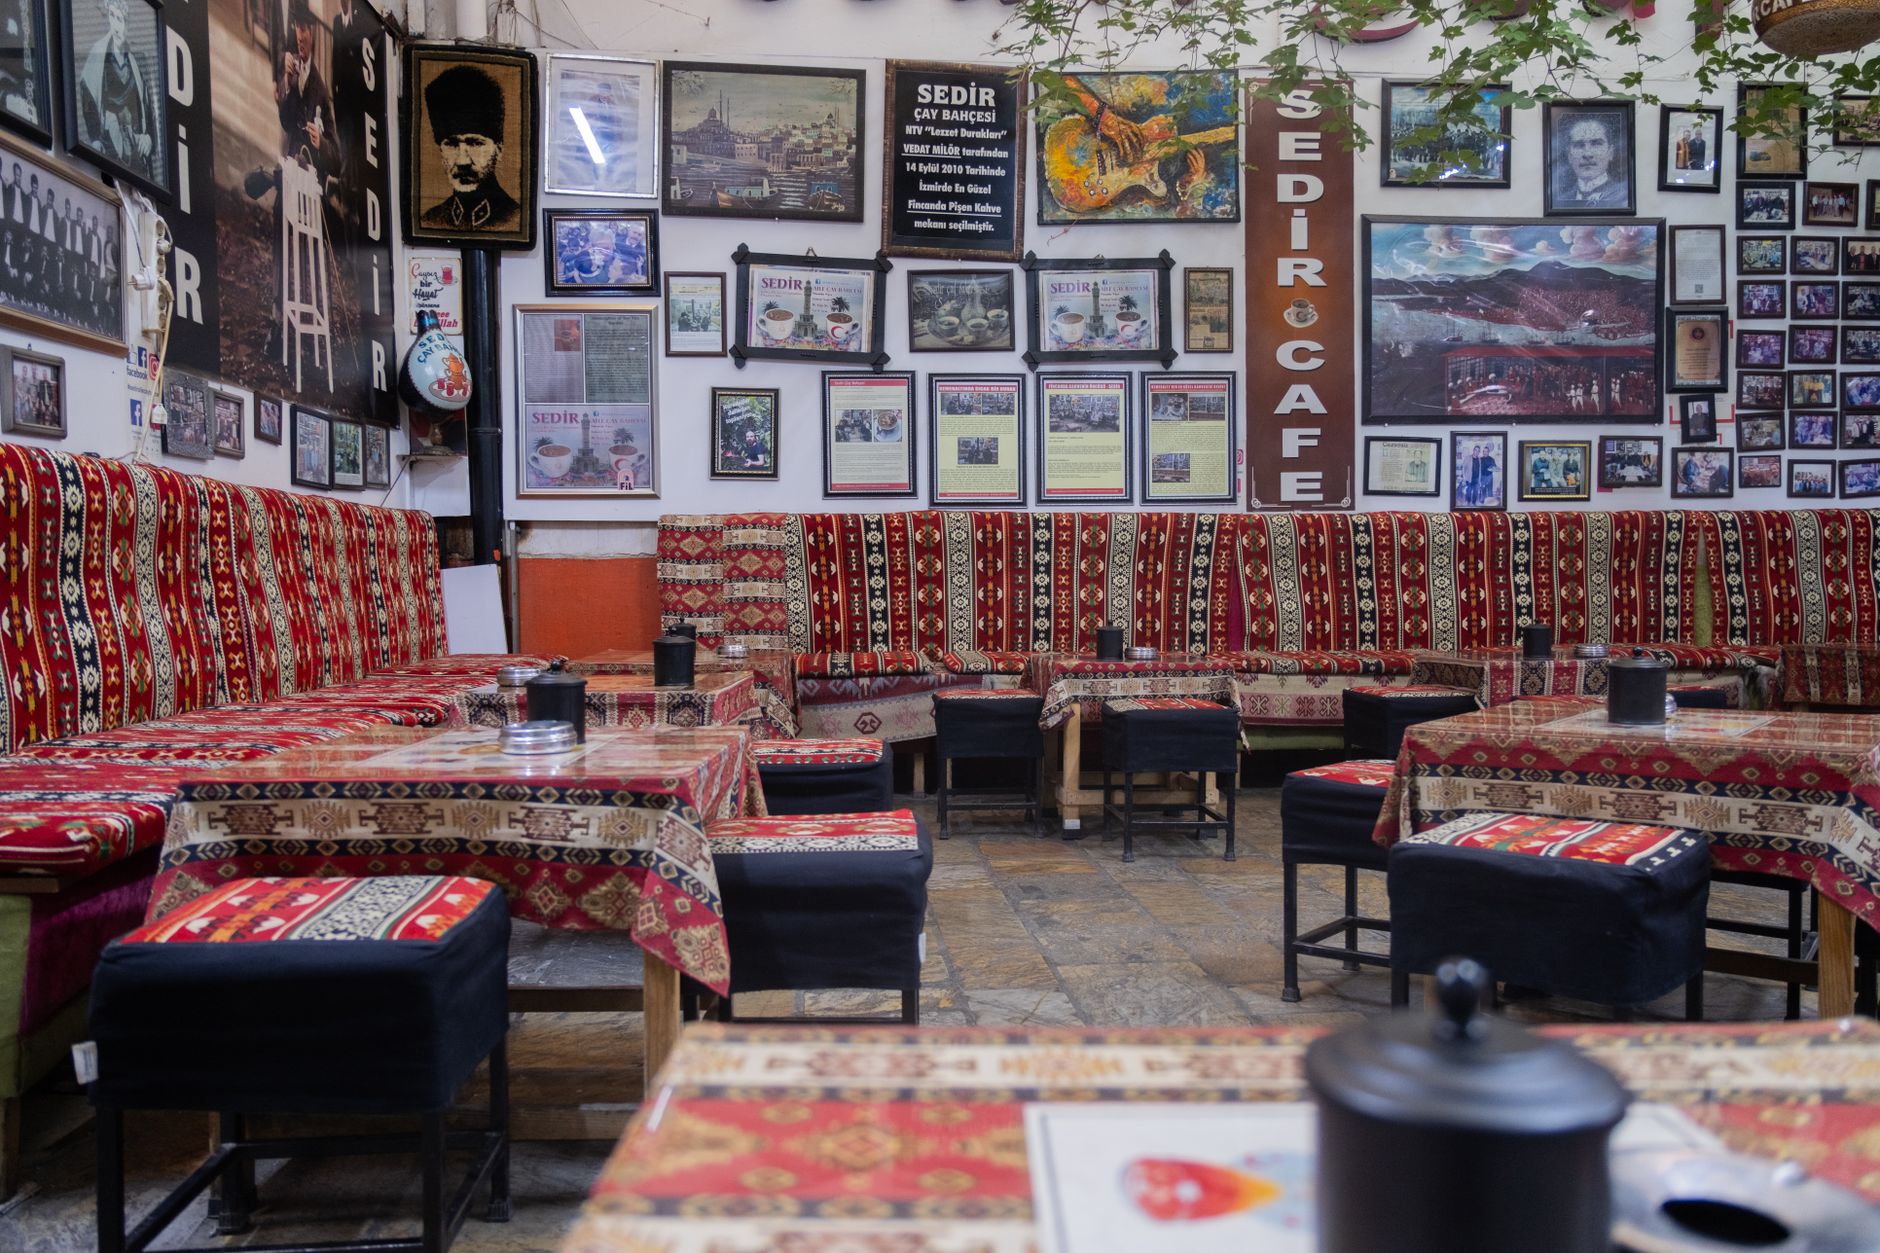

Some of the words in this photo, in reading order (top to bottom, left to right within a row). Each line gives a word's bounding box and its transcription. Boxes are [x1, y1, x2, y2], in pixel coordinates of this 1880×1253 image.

[917, 81, 996, 107] SEDİR
[914, 108, 938, 122] ÇAY
[942, 109, 996, 125] BAHÇESİ
[905, 125, 923, 135] NTV
[903, 143, 930, 154] VEDAT
[932, 143, 960, 155] MİLÖR
[962, 146, 1009, 158] tarafından
[165, 0, 203, 325] DİR
[905, 162, 916, 172] 14
[918, 162, 939, 174] Eylül
[941, 164, 963, 174] 2010
[965, 165, 1006, 176] Tarihinde
[919, 178, 952, 192] İzmirde
[954, 183, 965, 193] En
[967, 184, 991, 194] Güzel
[1276, 89, 1328, 287] SEDİR
[908, 199, 946, 211] Fincanda
[948, 201, 972, 213] Pişen
[974, 202, 1002, 213] Kahve
[362, 37, 388, 393] SEDİR
[914, 218, 946, 229] mekanı
[948, 220, 995, 233] seçilmiştir.
[761, 276, 803, 291] SEDİR
[1050, 280, 1091, 294] SEDİR
[412, 287, 443, 301] Hayat
[126, 365, 148, 379] facebook
[532, 410, 580, 425] SEDİR
[1274, 340, 1328, 502] CAFE
